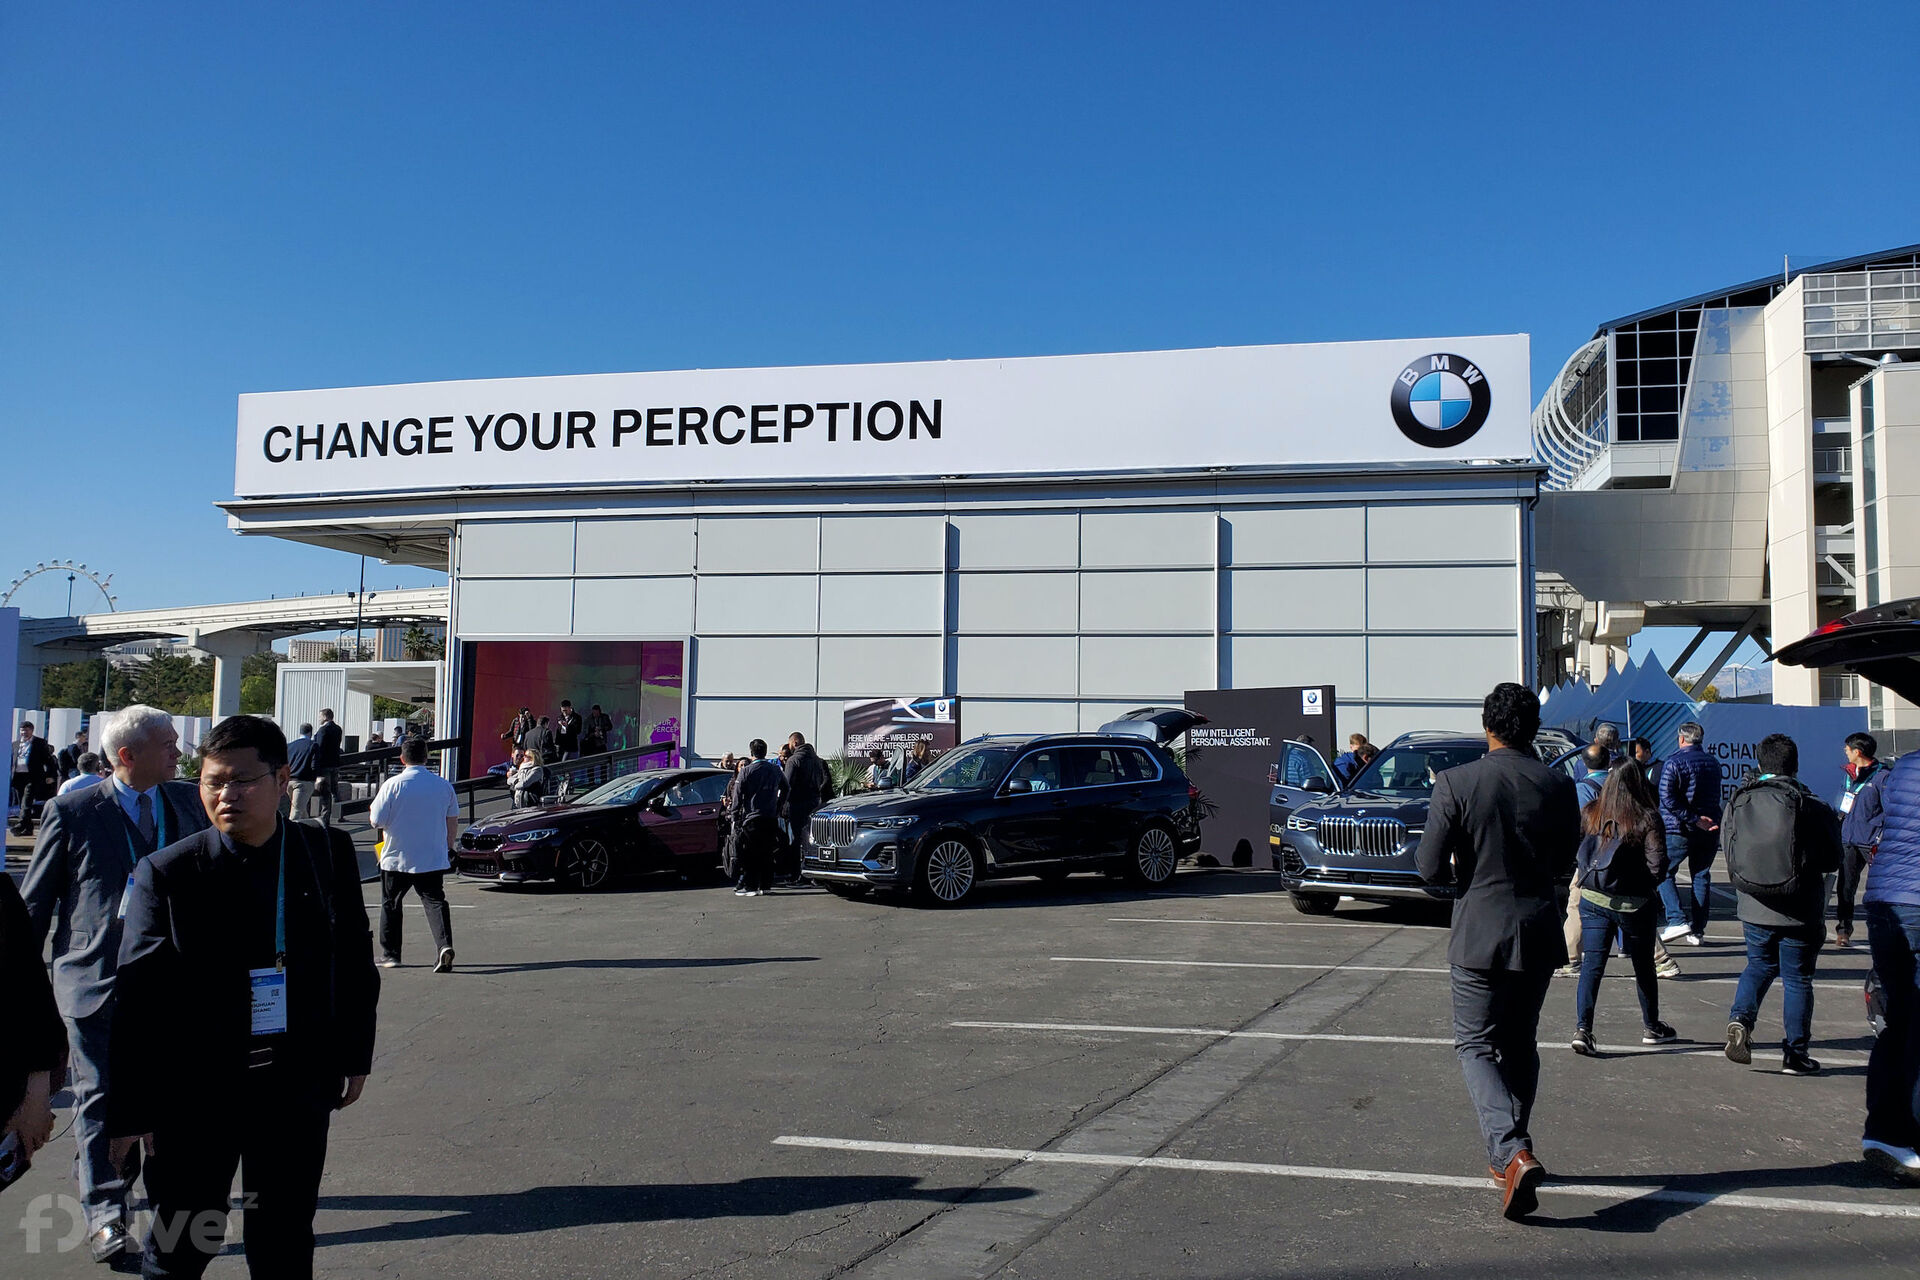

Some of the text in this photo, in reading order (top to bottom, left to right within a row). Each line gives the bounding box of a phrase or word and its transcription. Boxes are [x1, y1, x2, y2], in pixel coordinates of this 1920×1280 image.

[1400, 355, 1482, 386] BMW
[263, 399, 943, 463] CHANGE YOUR PERCEPTION
[890, 733, 919, 741] WIRELESS
[1191, 728, 1256, 737] BMW INTELLIGENT
[848, 741, 916, 750] SEAMLESSLY INTEGRATE
[1191, 737, 1271, 746] PERSONAL ASSISTANT.
